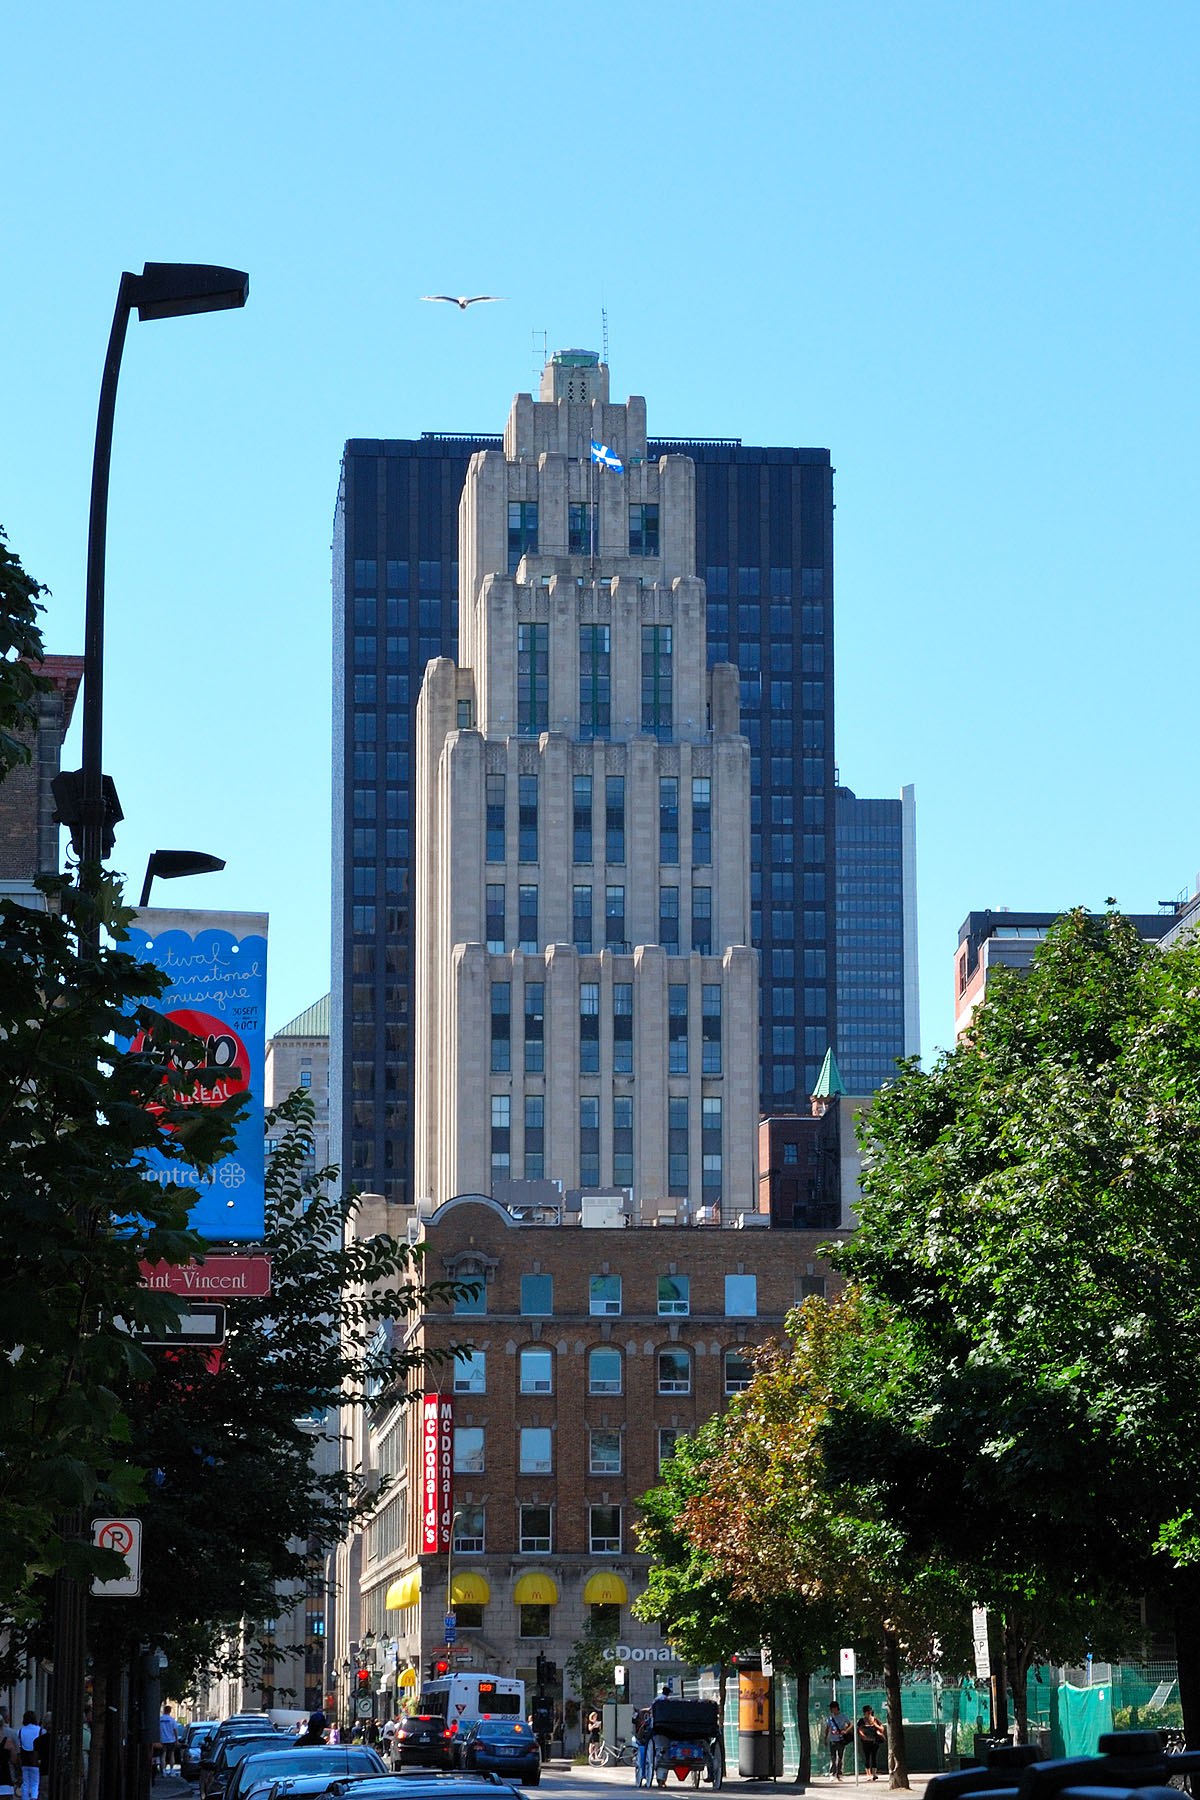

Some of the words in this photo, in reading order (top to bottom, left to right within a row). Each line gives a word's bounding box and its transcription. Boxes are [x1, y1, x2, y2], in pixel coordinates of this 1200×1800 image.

[161, 988, 251, 1011] musique
[241, 1020, 258, 1030] OCT
[137, 1271, 248, 1289] aint-Vincent
[424, 1403, 438, 1544] McDonald's
[440, 1403, 452, 1543] McDonald's
[480, 1684, 492, 1692] 129
